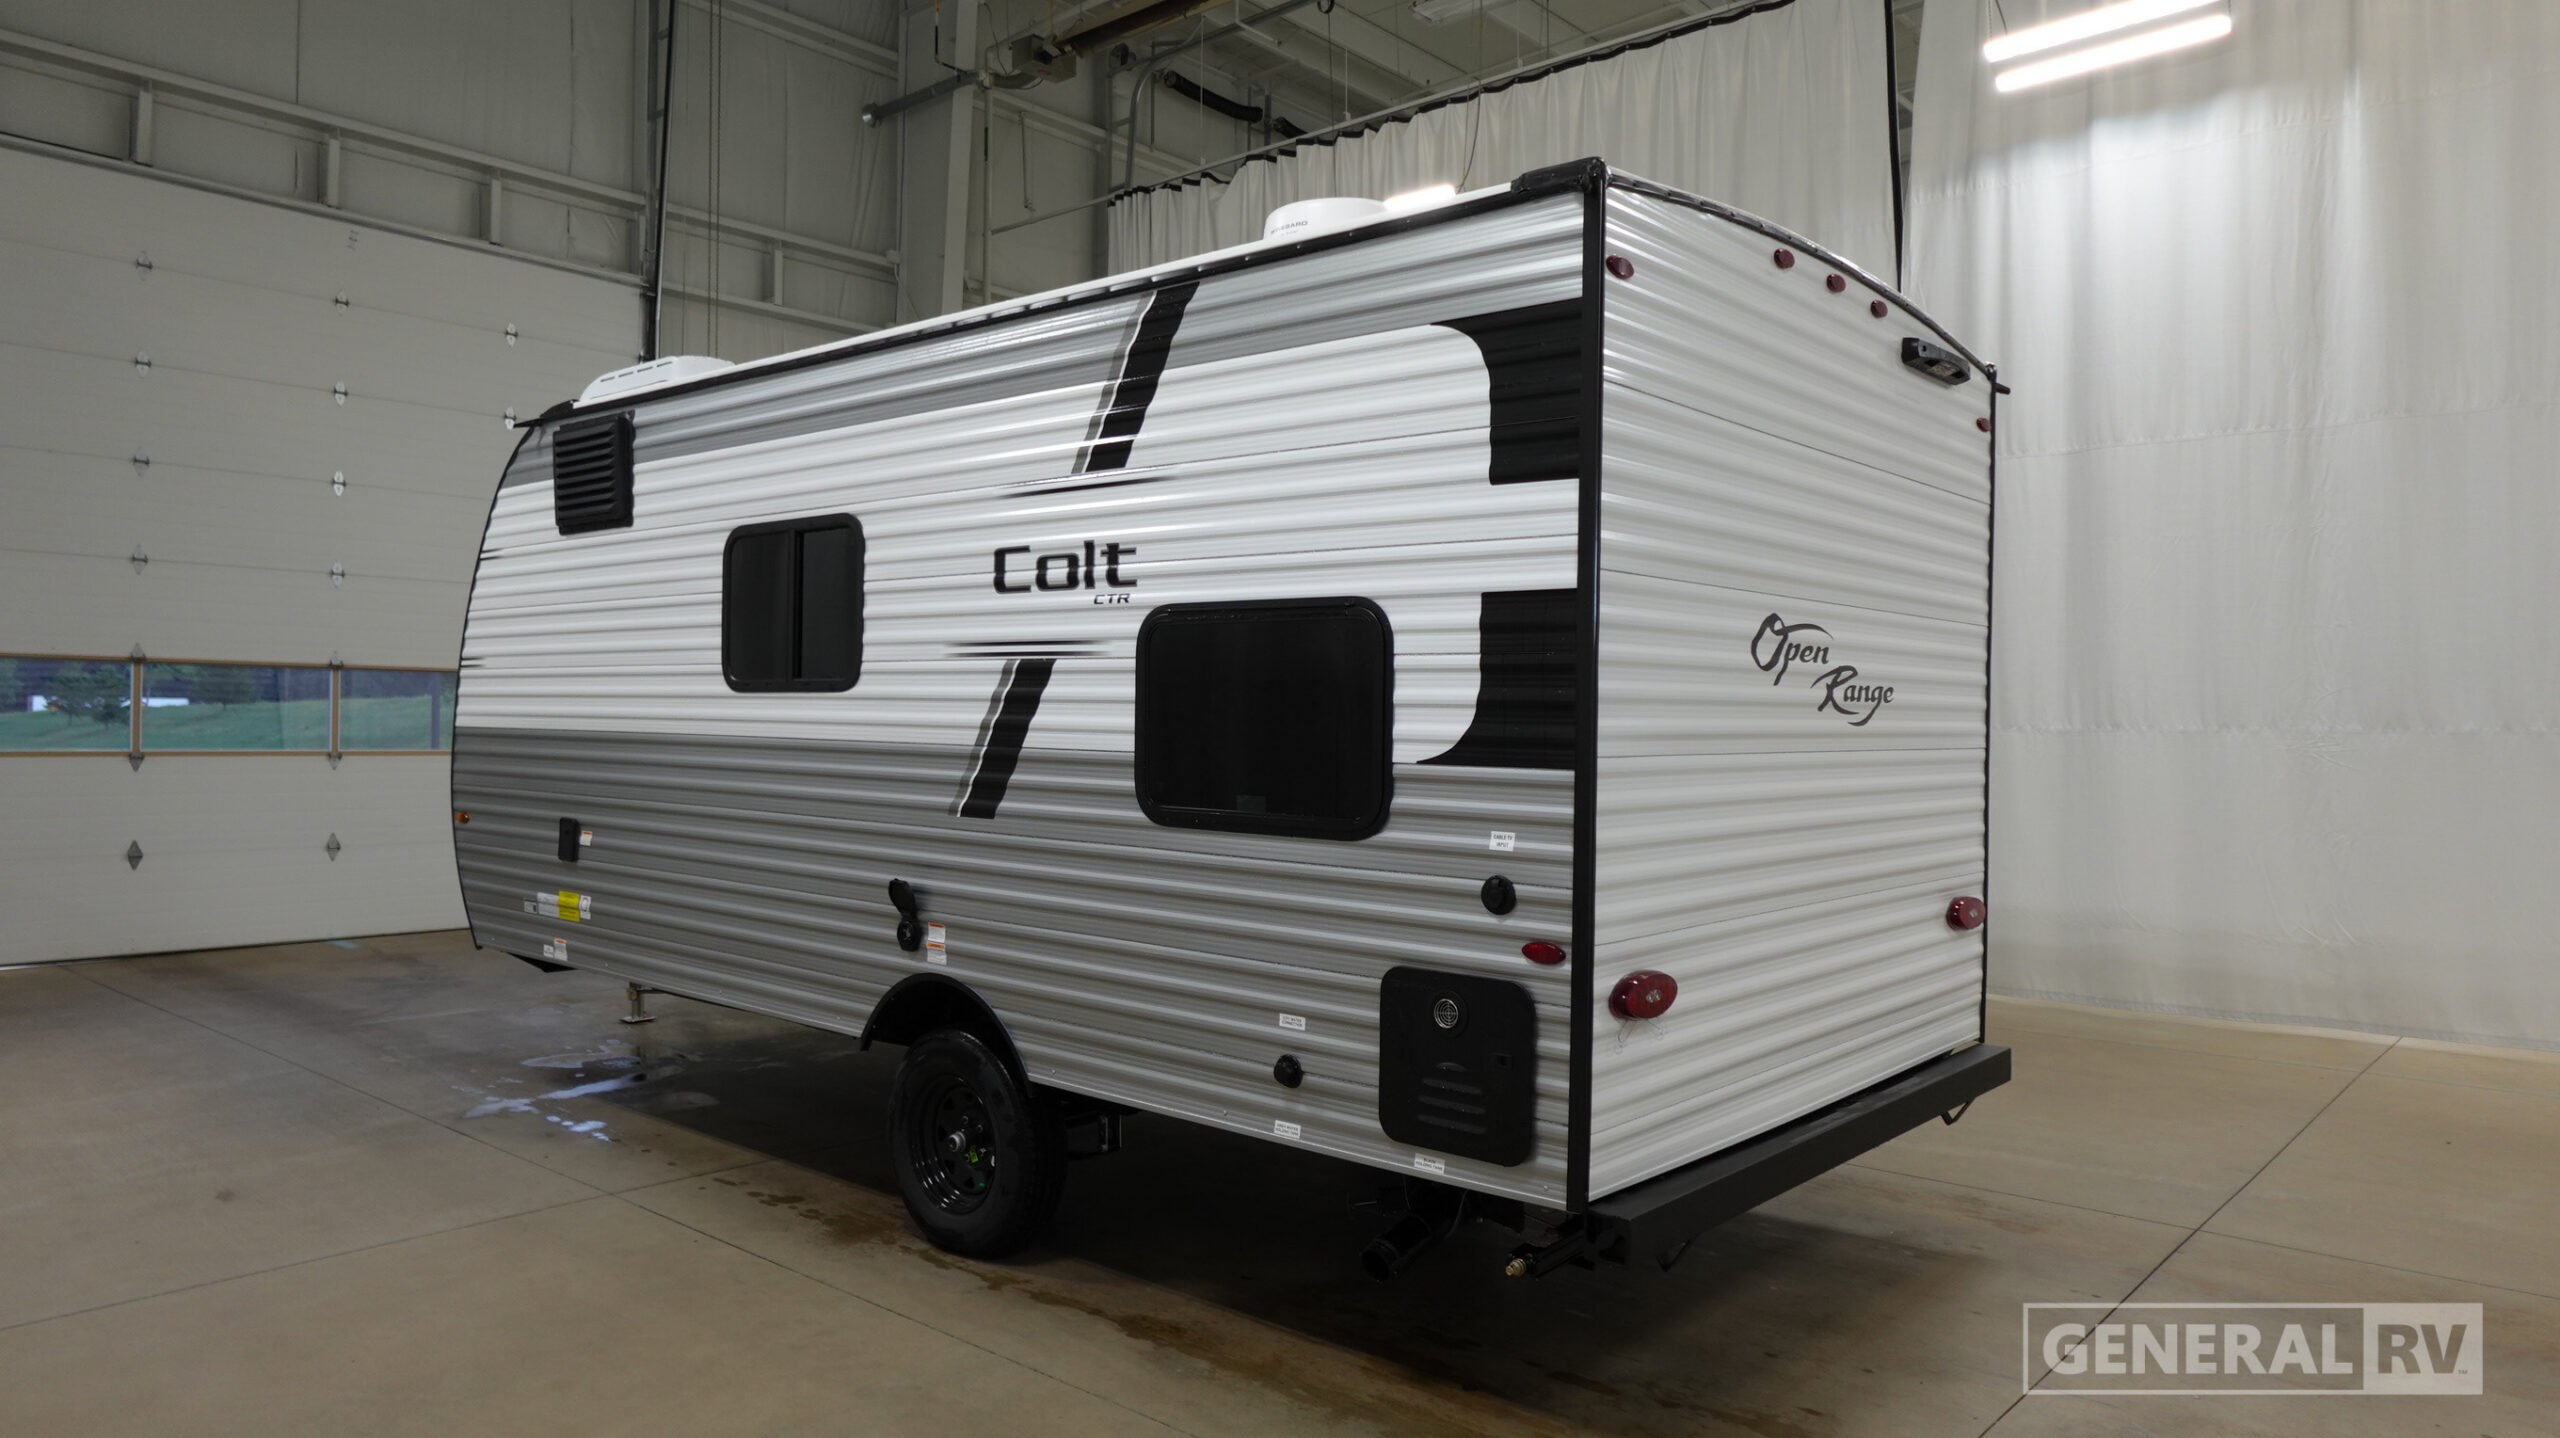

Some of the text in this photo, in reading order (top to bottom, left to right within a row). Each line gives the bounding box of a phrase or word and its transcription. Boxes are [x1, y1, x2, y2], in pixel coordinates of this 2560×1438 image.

[993, 540, 1138, 594] Colt
[1093, 592, 1130, 605] CTR
[1751, 612, 1834, 686] Open
[1810, 665, 1894, 726] Range
